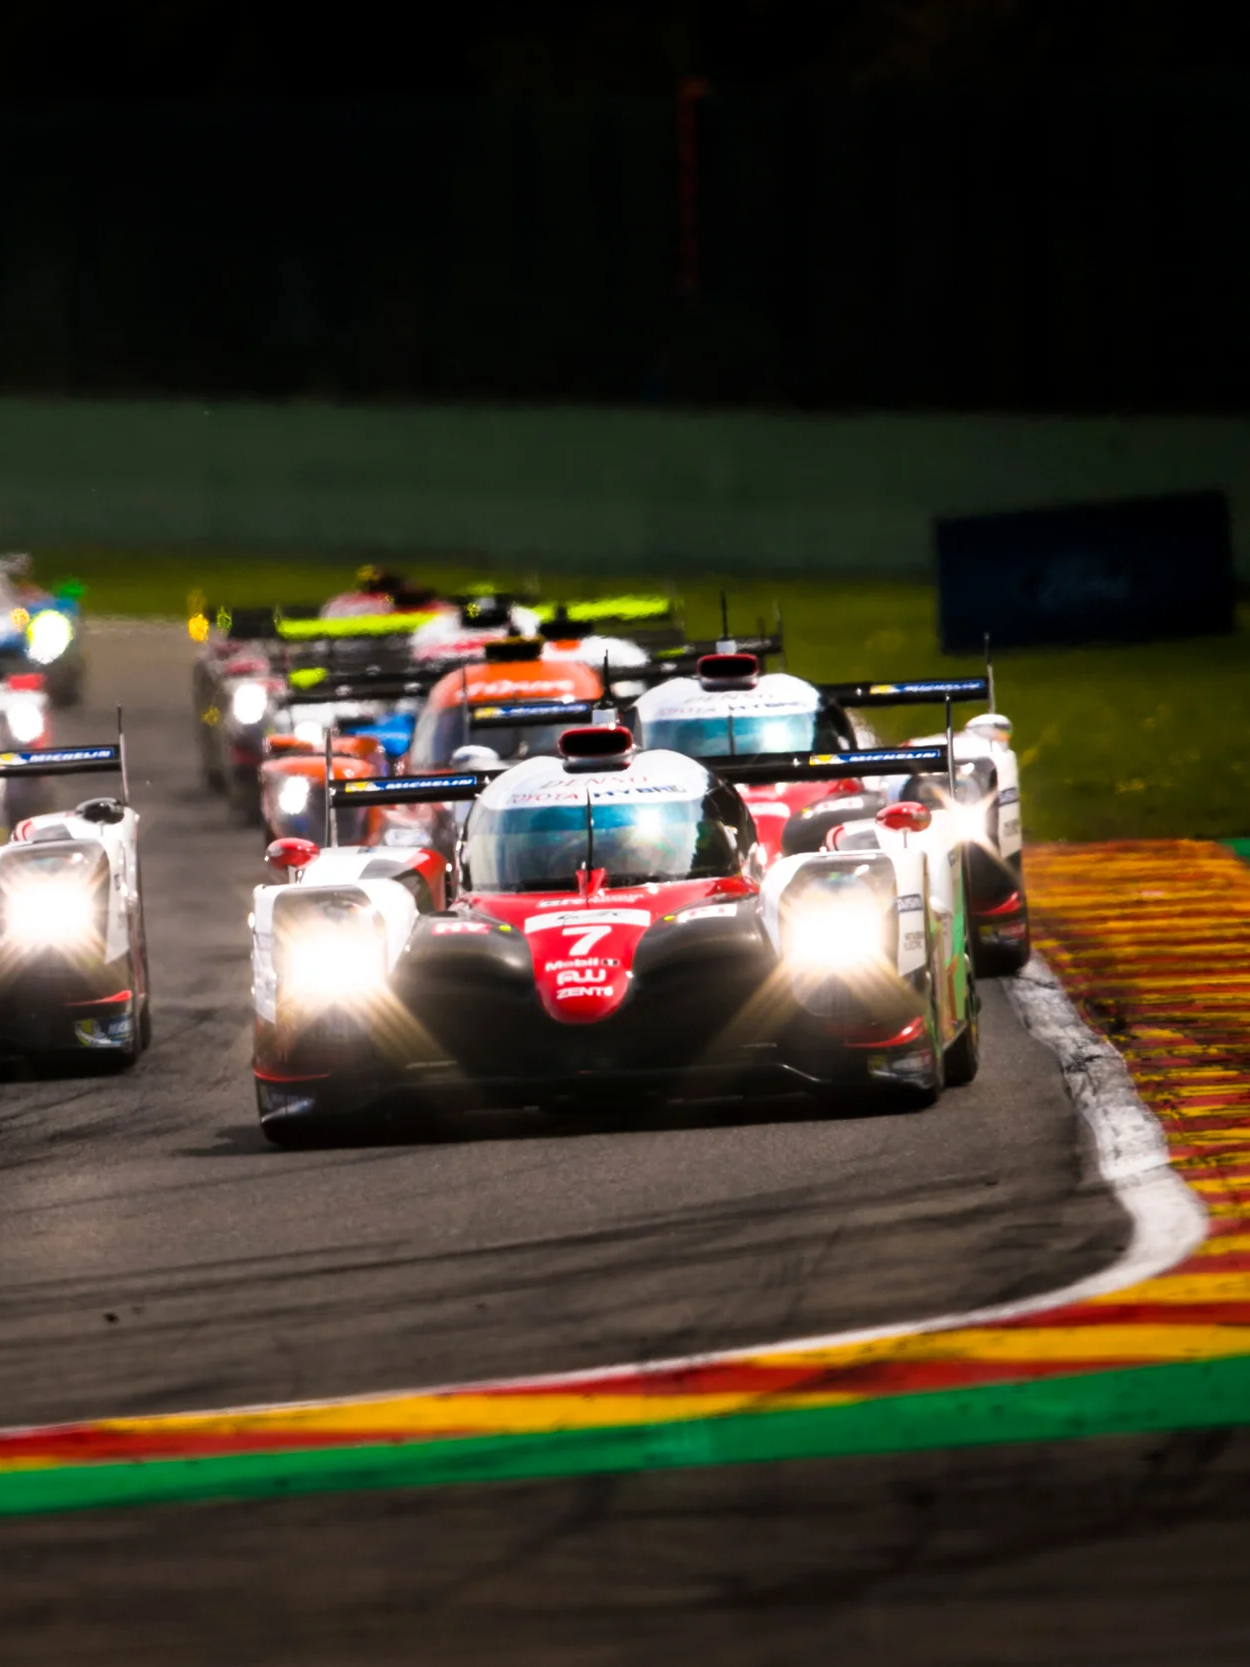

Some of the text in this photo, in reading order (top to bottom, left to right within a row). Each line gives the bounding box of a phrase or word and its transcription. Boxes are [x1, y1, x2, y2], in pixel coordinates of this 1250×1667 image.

[29, 750, 111, 762] MICHELIN
[848, 752, 937, 762] MICHELIN
[385, 778, 474, 790] MICHELIN
[561, 925, 612, 956] 7
[545, 957, 599, 972] Mobil
